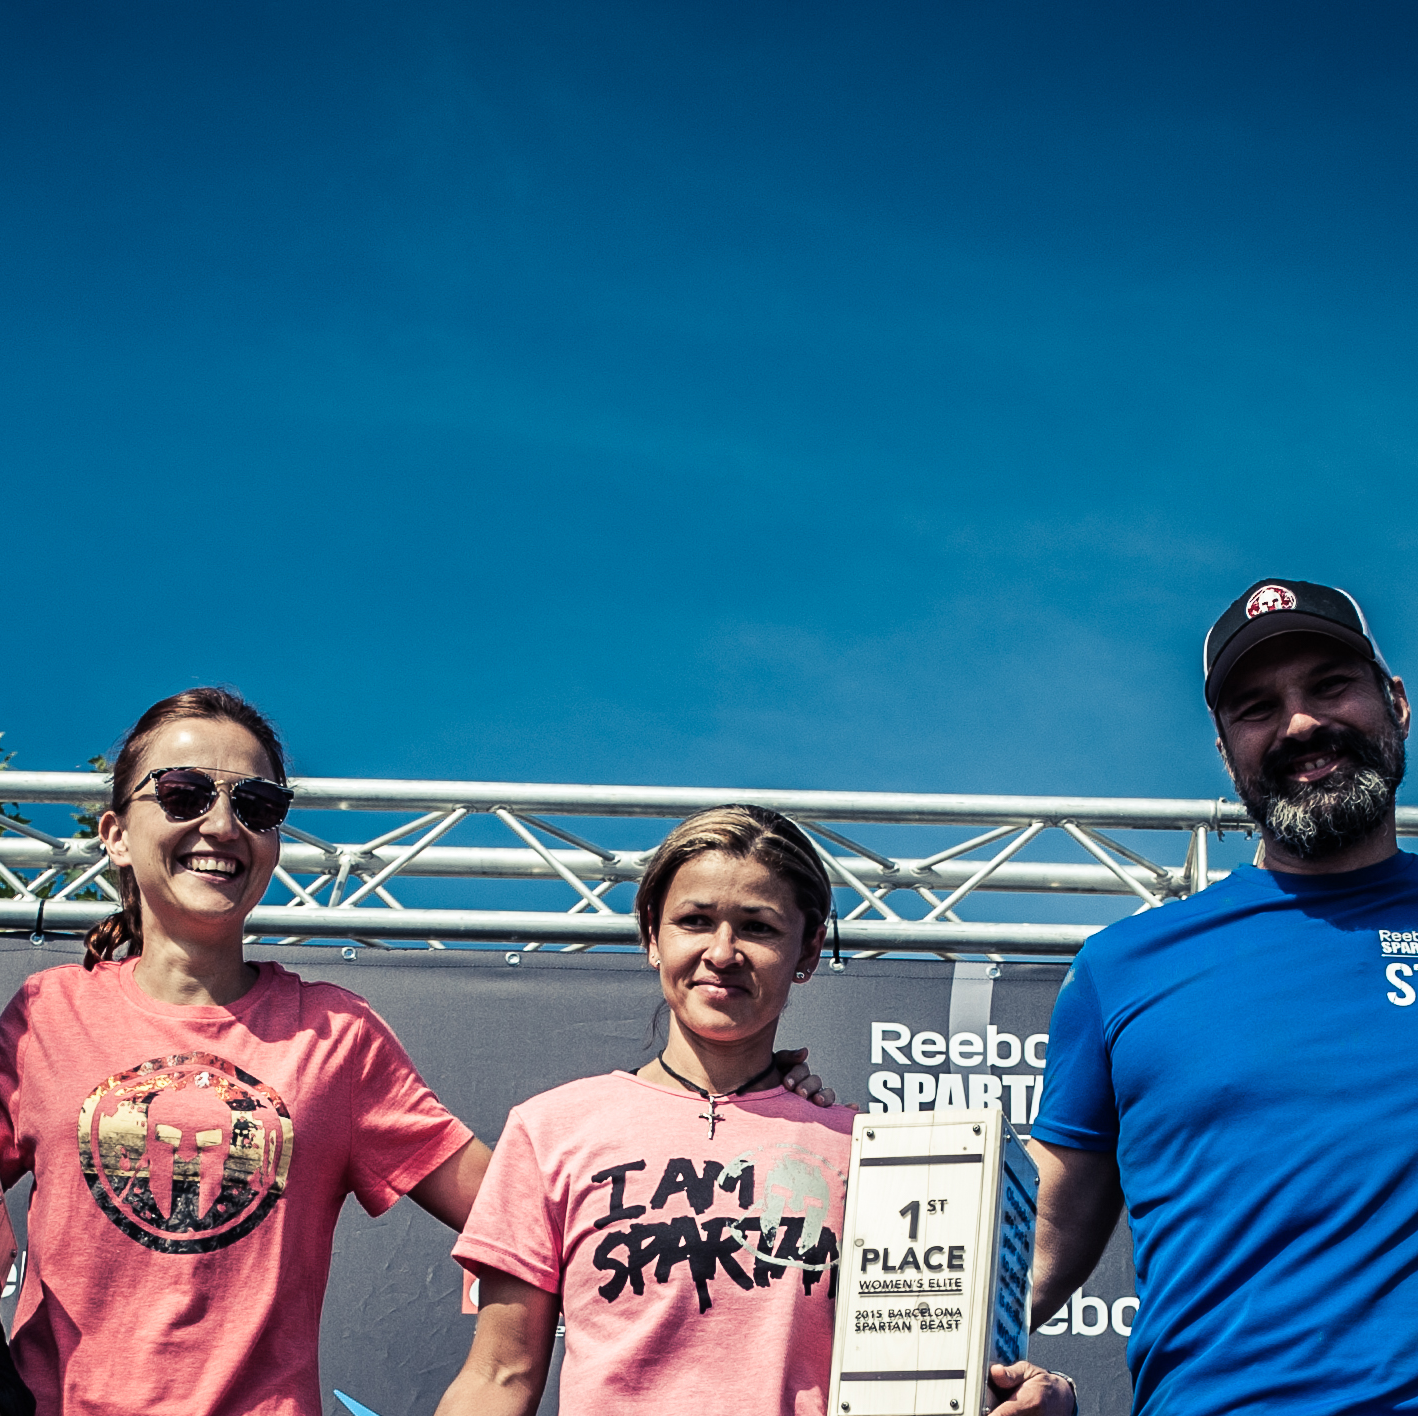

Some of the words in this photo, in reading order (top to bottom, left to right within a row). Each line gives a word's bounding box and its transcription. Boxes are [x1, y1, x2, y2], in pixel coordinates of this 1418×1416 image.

[591, 1159, 647, 1230] I
[650, 1157, 754, 1215] AM
[861, 1245, 965, 1273] PLACE
[859, 1279, 923, 1290] WOMEN'S
[928, 1278, 962, 1288] ELITE
[855, 1310, 883, 1319] 2015
[888, 1308, 962, 1318] BARCELONA
[855, 1321, 912, 1332] SPARTAN
[920, 1320, 961, 1330] BEAST
